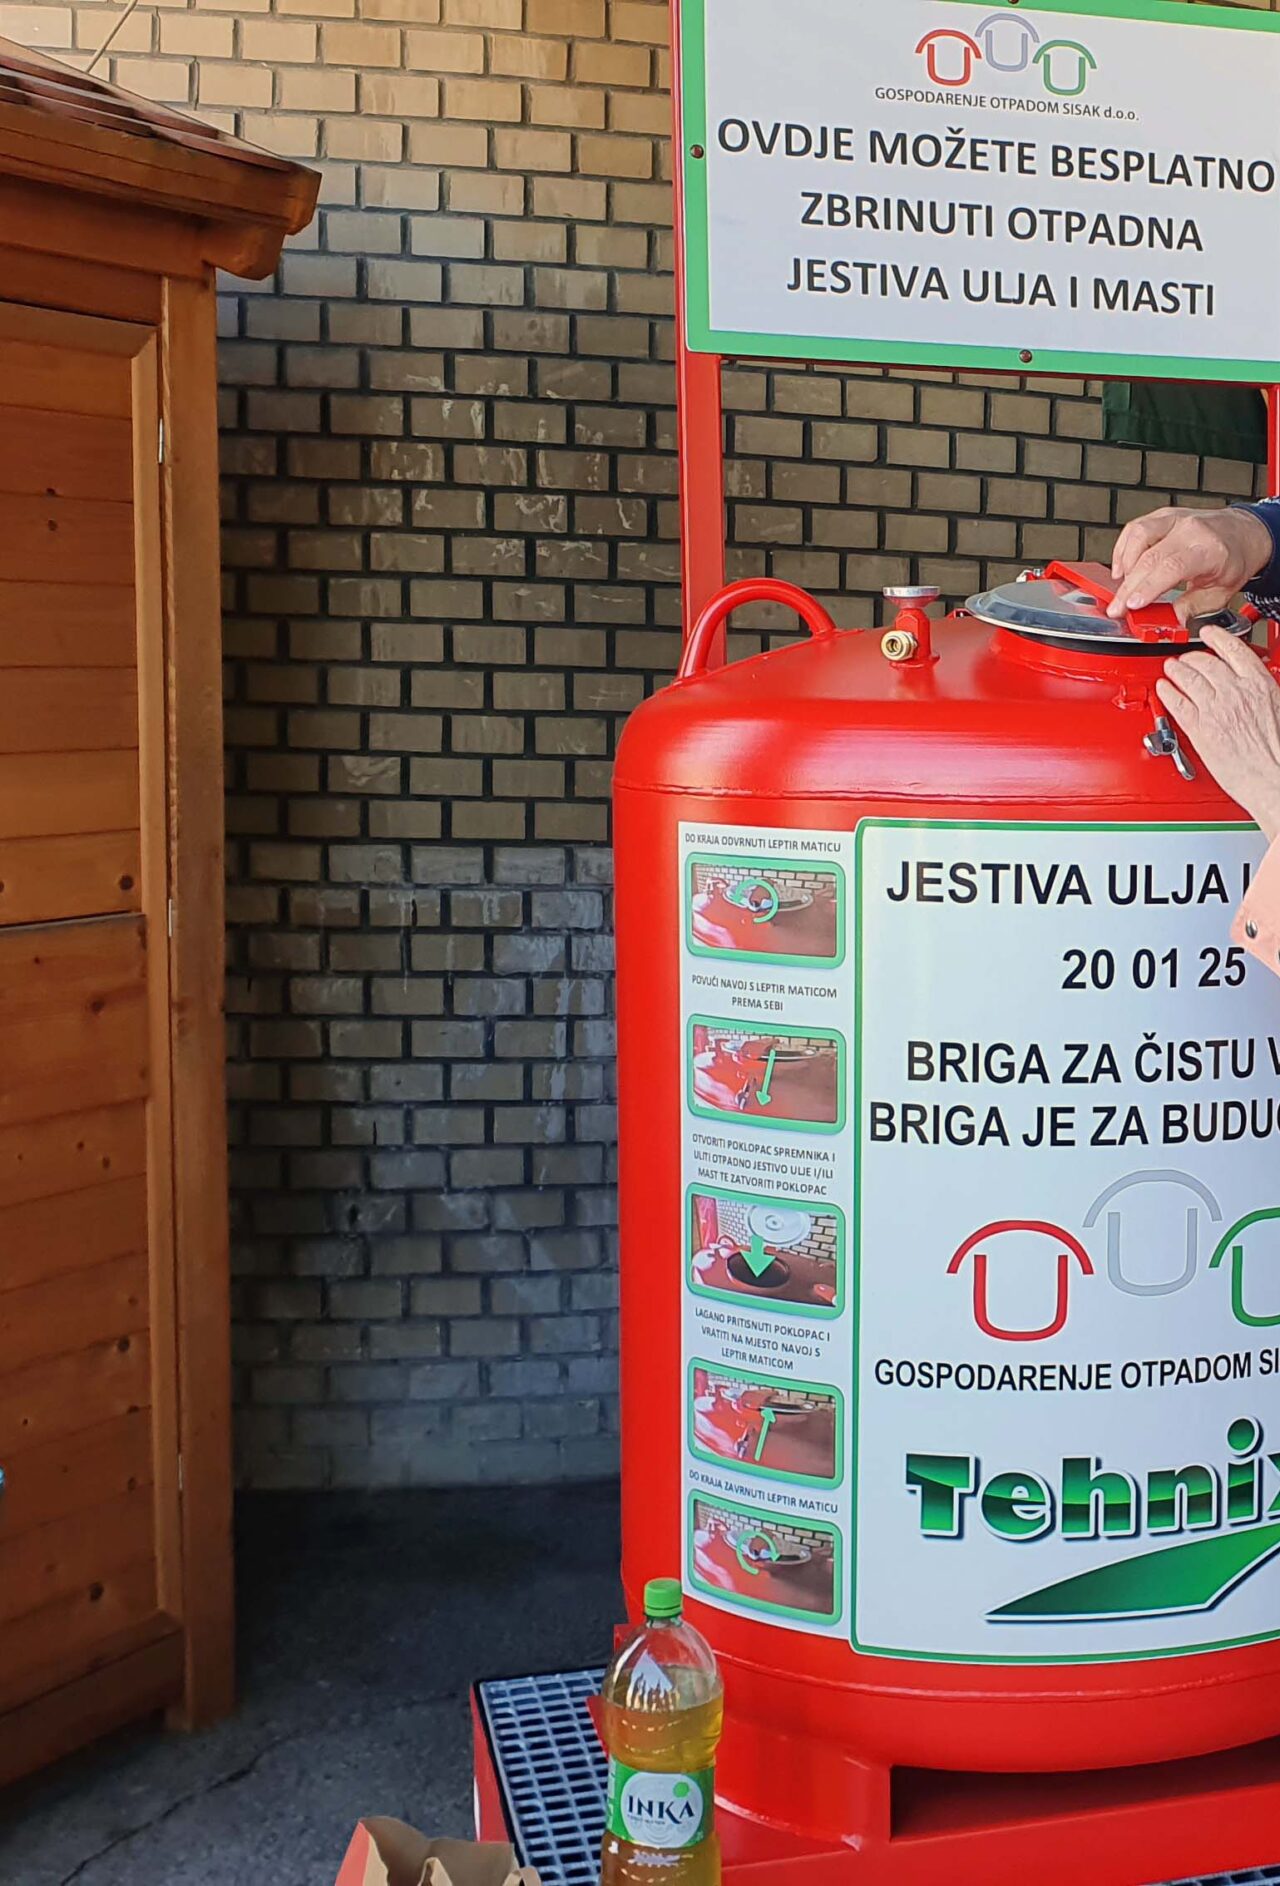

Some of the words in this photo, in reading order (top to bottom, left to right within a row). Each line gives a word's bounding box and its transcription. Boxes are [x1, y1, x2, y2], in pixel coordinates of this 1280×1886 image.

[875, 87, 987, 108] GOSPODARENJE
[990, 95, 1059, 114] OTPADOM
[1062, 100, 1101, 118] SISAK
[1103, 105, 1140, 122] d.o.o.
[717, 117, 853, 162] OVDJE
[870, 126, 1037, 176] MOŽETE
[1052, 144, 1276, 193] BESPLATNO
[800, 191, 993, 237] ZBRINUTI
[1008, 207, 1203, 252] OTPADNA
[787, 258, 949, 301] JESTIVA
[963, 269, 1056, 308] ULJA
[1071, 276, 1078, 308] I
[1093, 277, 1215, 316] MASTI
[685, 833, 695, 843] DO
[697, 834, 720, 845] KRAJA
[721, 836, 766, 848] ODVRNUTI
[768, 839, 799, 850] LEPTIR
[801, 841, 841, 852] MATICU
[886, 861, 1092, 905] JESTIVA
[1108, 863, 1230, 905] ULJA
[1062, 948, 1115, 990] 20
[1133, 947, 1178, 988] 01
[1199, 946, 1246, 987] 25
[720, 978, 747, 991] NAVOJ
[750, 981, 754, 991] S
[756, 982, 786, 994] LEPTIR
[788, 985, 837, 998] MATICOM
[731, 997, 762, 1009] PREMA
[764, 1000, 783, 1011] SEBI
[908, 1040, 1050, 1085] BRIGA
[1062, 1043, 1122, 1084] ZA
[1134, 1032, 1256, 1084] ČISTU
[870, 1101, 1010, 1147] BRIGA
[1021, 1105, 1075, 1147] JE
[1091, 1105, 1150, 1147] ZA
[692, 1133, 725, 1149] OTVORITI
[728, 1139, 772, 1156] POKLOPAC
[774, 1146, 829, 1162] SPREMNIKA
[832, 1152, 835, 1162] I
[694, 1150, 711, 1162] ULITI
[712, 1154, 751, 1170] OTPADNO
[753, 1159, 788, 1174] JESTIVO
[790, 1164, 812, 1176] ULJE
[814, 1167, 833, 1179] I/ILI
[698, 1167, 718, 1180] MAST
[720, 1170, 729, 1182] TE
[731, 1172, 774, 1190] ZATVORITI
[776, 1180, 827, 1196] POKLOPAC
[695, 1307, 725, 1323] LAGANO
[726, 1314, 772, 1334] PRITISNUTI
[774, 1323, 824, 1340] POKLOPAC
[827, 1332, 830, 1342] I
[701, 1325, 730, 1341] VRATITI
[732, 1332, 744, 1344] NA
[746, 1336, 779, 1351] MJESTO
[781, 1342, 813, 1357] NAVOJ
[815, 1347, 821, 1357] S
[722, 1347, 748, 1362] LEPTIR
[750, 1352, 794, 1370] MATICOM
[874, 1358, 1112, 1392] GOSPODARENJE
[1121, 1351, 1253, 1389] OTPADOM
[689, 1469, 700, 1480] DO
[701, 1472, 723, 1489] KRAJA
[724, 1480, 765, 1502] ZAVRNUTI
[767, 1491, 796, 1507] LEPTIR
[799, 1498, 838, 1514] MATICU
[628, 1795, 694, 1824] INKA
